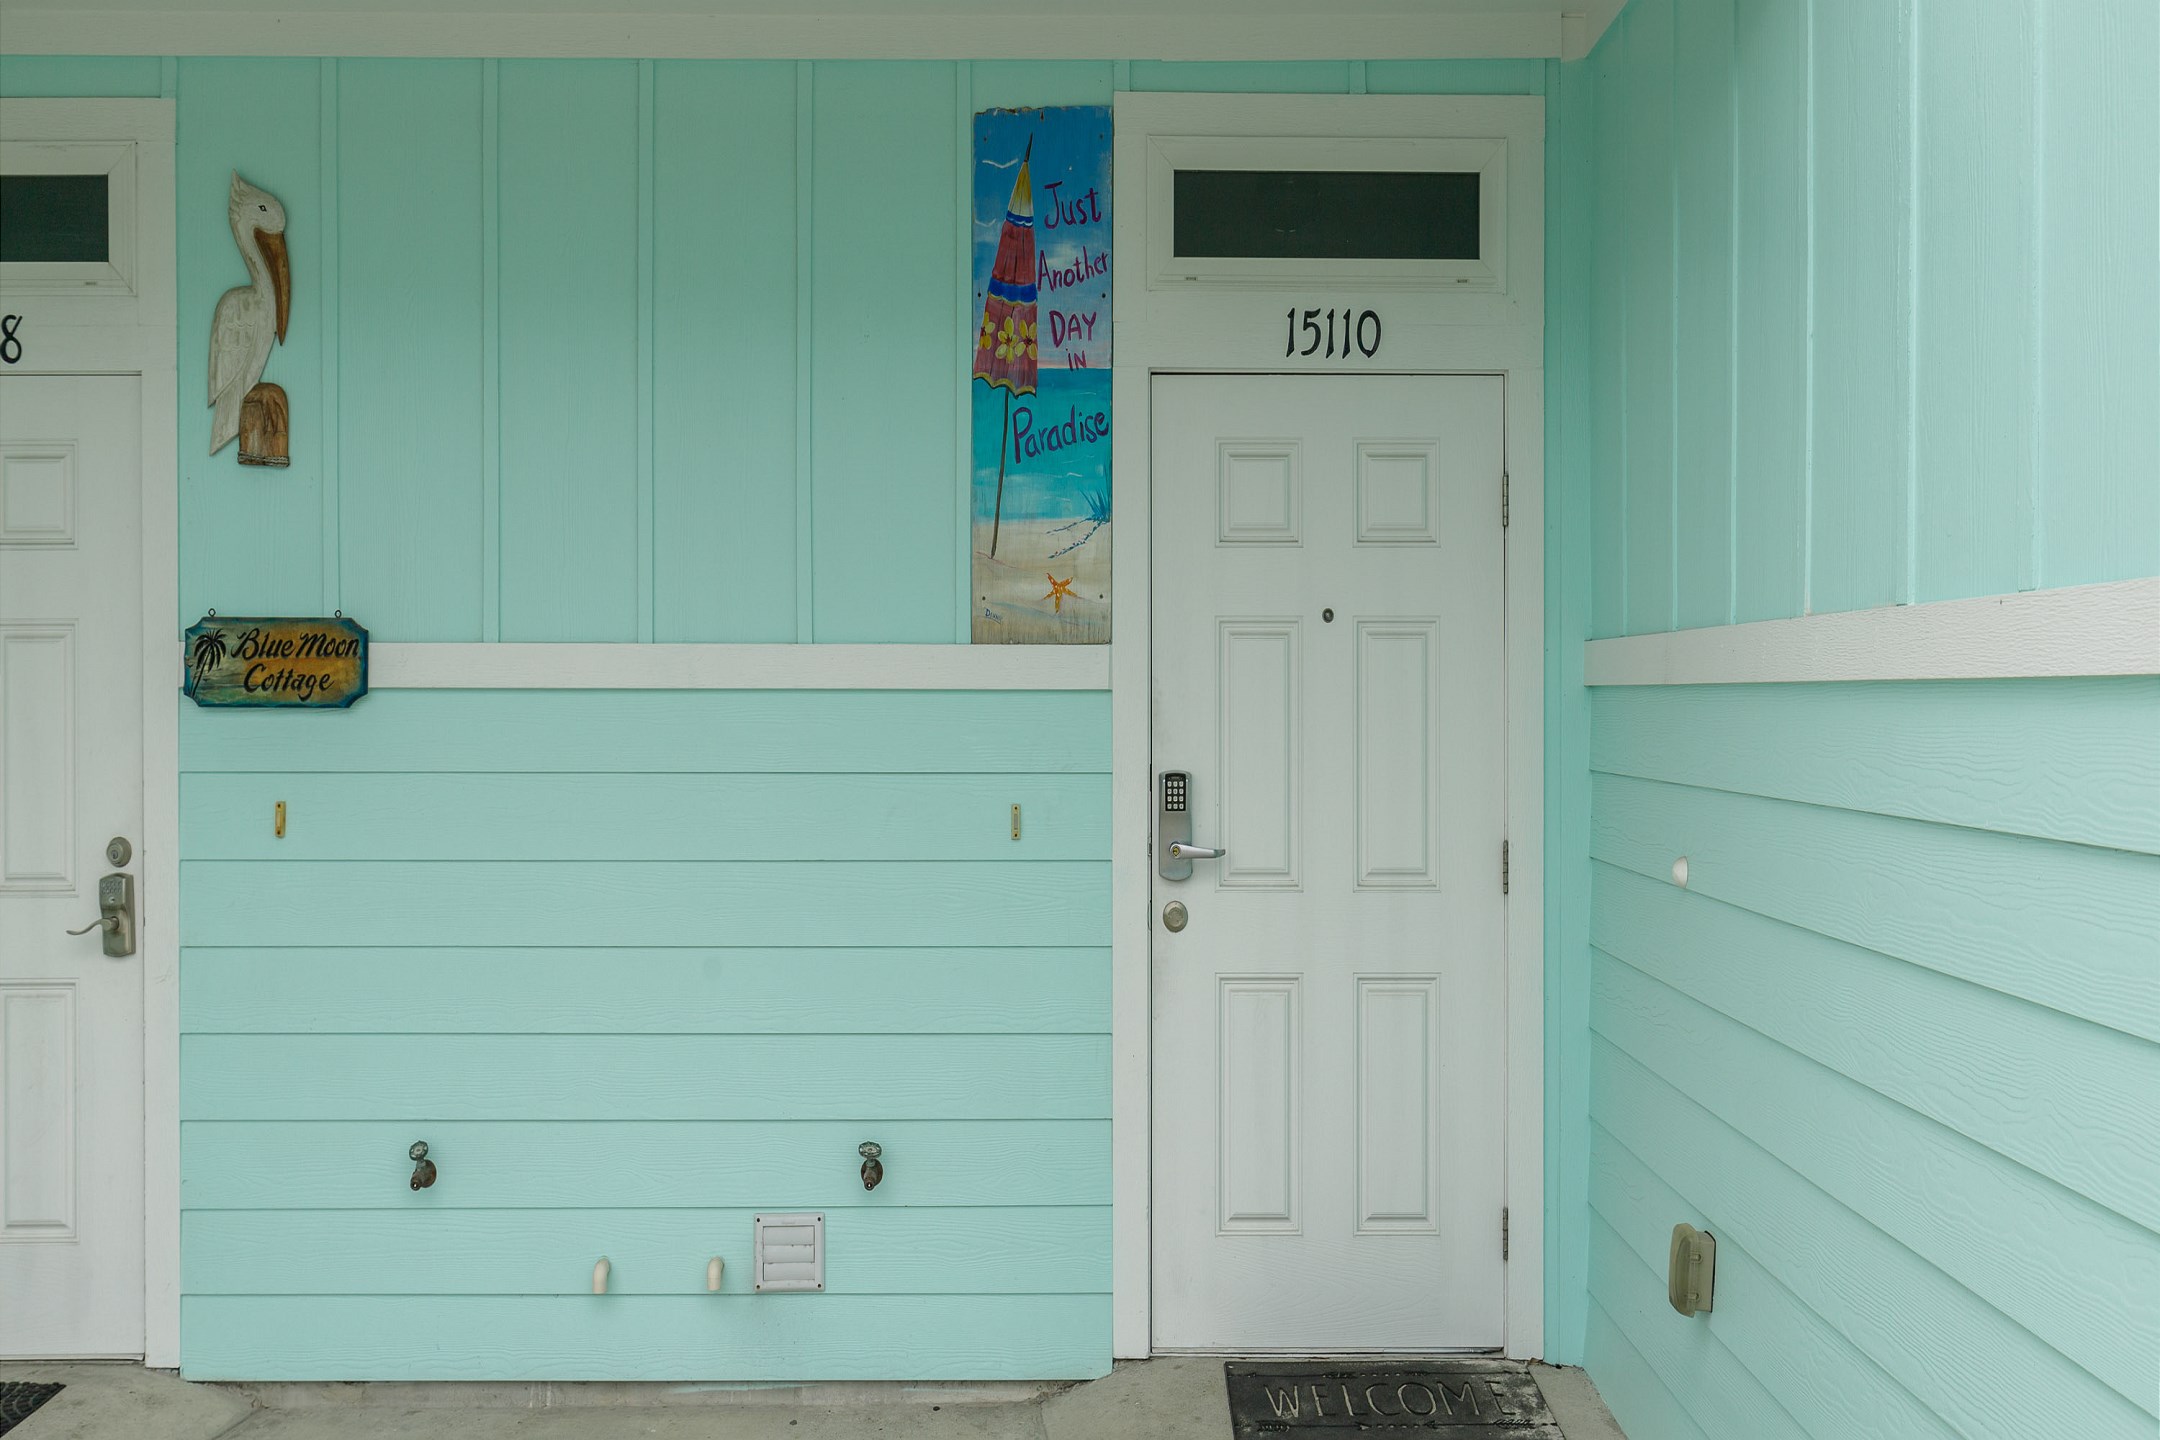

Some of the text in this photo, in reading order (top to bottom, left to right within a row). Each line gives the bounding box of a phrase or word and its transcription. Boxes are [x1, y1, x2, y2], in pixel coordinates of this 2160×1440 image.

[1044, 181, 1102, 229] Just
[1037, 246, 1109, 292] Another
[1049, 310, 1097, 348] DAY
[1286, 307, 1382, 360] 15110
[1012, 405, 1109, 463] Paradise
[230, 627, 360, 661] Blue Moon
[243, 663, 335, 702] Cottage
[1263, 1380, 1517, 1418] WELCOME
